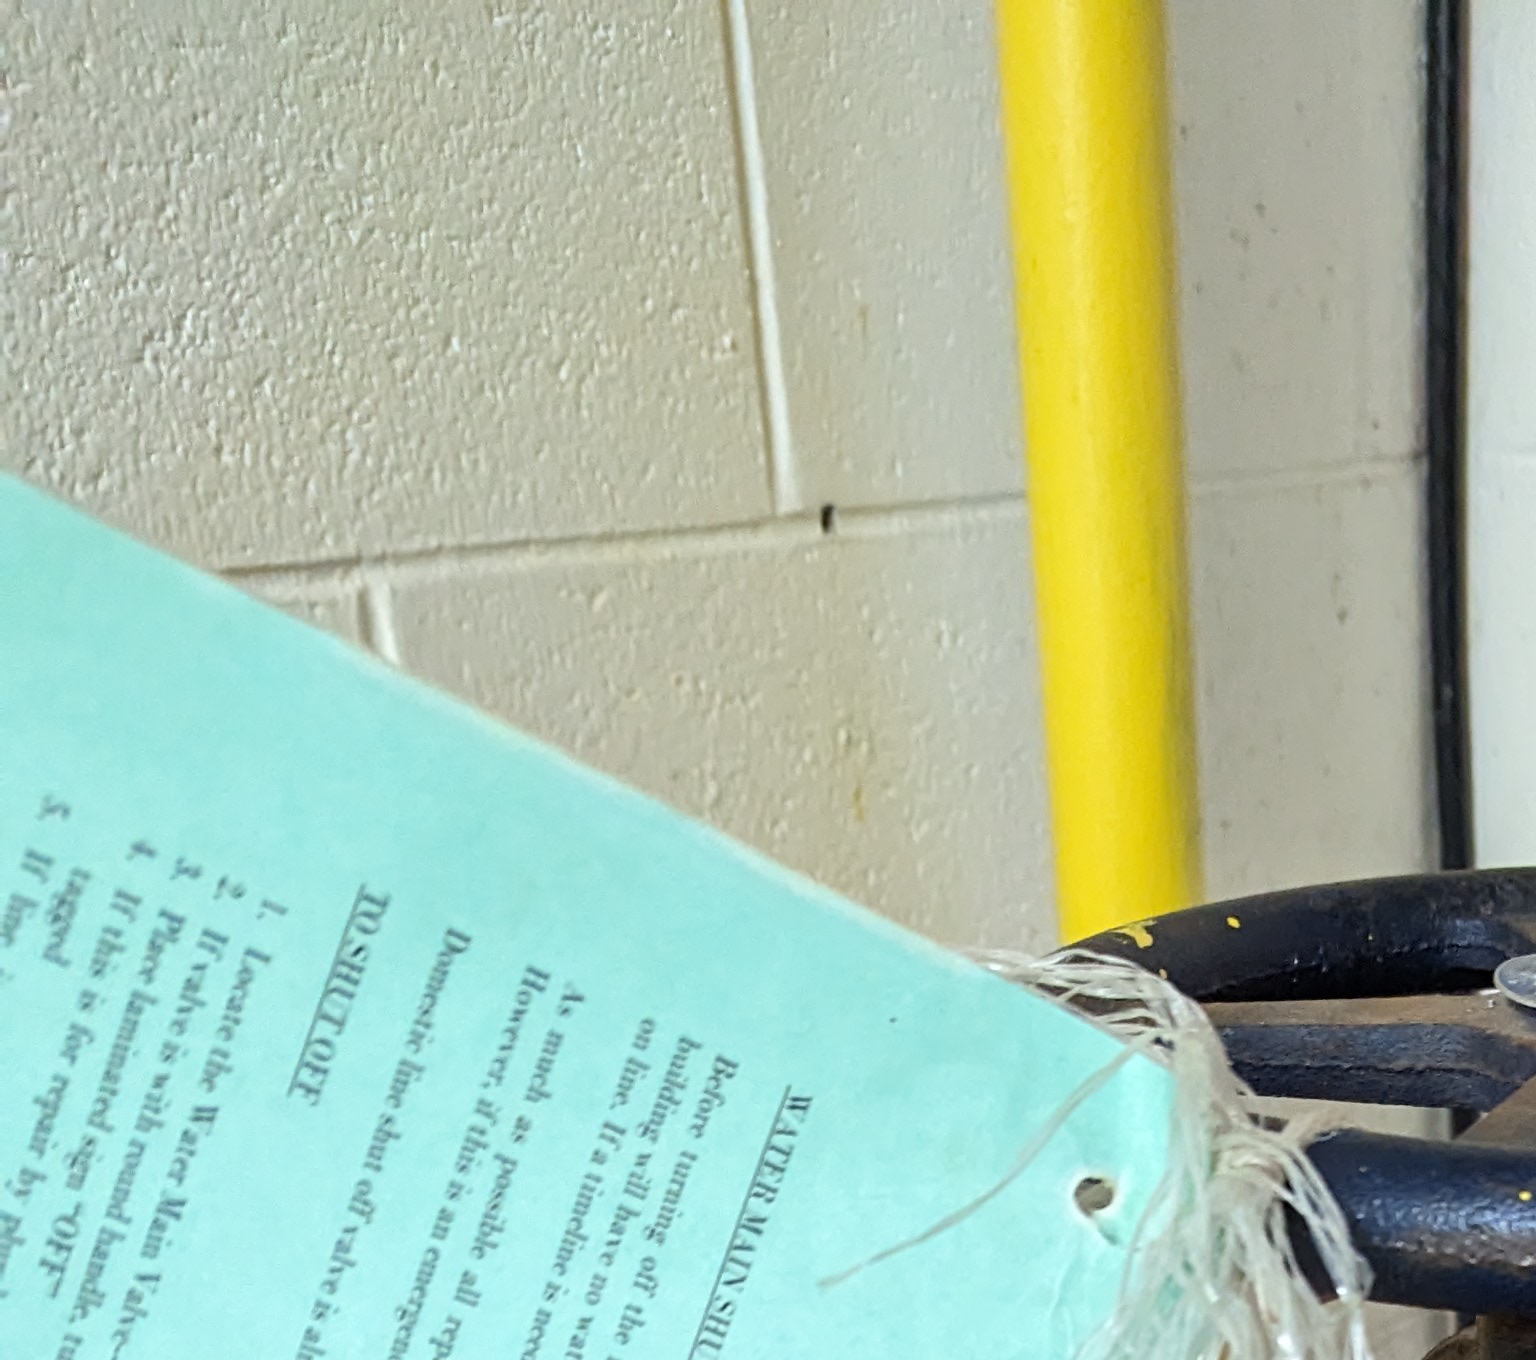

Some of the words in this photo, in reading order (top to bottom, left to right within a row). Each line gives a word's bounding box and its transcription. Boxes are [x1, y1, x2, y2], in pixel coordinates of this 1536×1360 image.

[20, 847, 55, 883] If
[125, 839, 157, 860] 4.
[169, 856, 202, 880] 3.
[109, 887, 142, 923] If
[212, 875, 246, 900] 2.
[256, 898, 288, 919] 1.
[349, 883, 391, 935] TO
[0, 892, 38, 948] line
[40, 866, 93, 968] tagged
[88, 925, 127, 980] this
[136, 906, 187, 985] Place
[195, 927, 230, 962] If
[76, 988, 106, 1013] is
[168, 962, 209, 1036] valve
[215, 946, 272, 1042] Locate
[313, 936, 370, 1036] SHUT
[404, 926, 472, 1054] Domestic
[556, 982, 585, 1017] As
[59, 1021, 95, 1066] for
[158, 1039, 188, 1065] is
[481, 964, 551, 1089] However,
[631, 1017, 656, 1051] on
[85, 988, 158, 1133] laminated
[197, 1046, 233, 1093] the
[291, 1032, 336, 1106] OFF
[384, 1057, 425, 1109] line
[523, 1028, 564, 1103] much
[608, 1056, 651, 1110] line.
[133, 1072, 171, 1133] with
[472, 1096, 502, 1127] if
[635, 1034, 703, 1144] building
[687, 1053, 739, 1139] Before
[26, 1072, 70, 1160] repair
[510, 1114, 532, 1144] as
[597, 1119, 628, 1151] If
[64, 1133, 102, 1191] sign
[166, 1105, 220, 1187] Water
[362, 1112, 401, 1173] shut
[454, 1124, 490, 1175] this
[589, 1147, 608, 1165] a
[753, 1095, 813, 1204] WATER
[5, 1165, 47, 1205] by
[104, 1137, 148, 1225] round
[346, 1178, 376, 1225] off
[444, 1179, 472, 1201] is
[622, 1152, 652, 1200] will
[641, 1150, 698, 1247] turning
[139, 1189, 188, 1259] Main
[429, 1205, 455, 1240] an
[469, 1151, 518, 1260] possible
[552, 1171, 604, 1277] timeline
[319, 1225, 359, 1295] valve
[598, 1202, 642, 1267] have
[722, 1207, 769, 1293] MAIN
[67, 1225, 126, 1324] handle,
[452, 1269, 482, 1307] all
[541, 1280, 569, 1303] is
[584, 1272, 608, 1306] no
[632, 1255, 658, 1299] off
[311, 1297, 339, 1322] is
[613, 1303, 645, 1345] the
